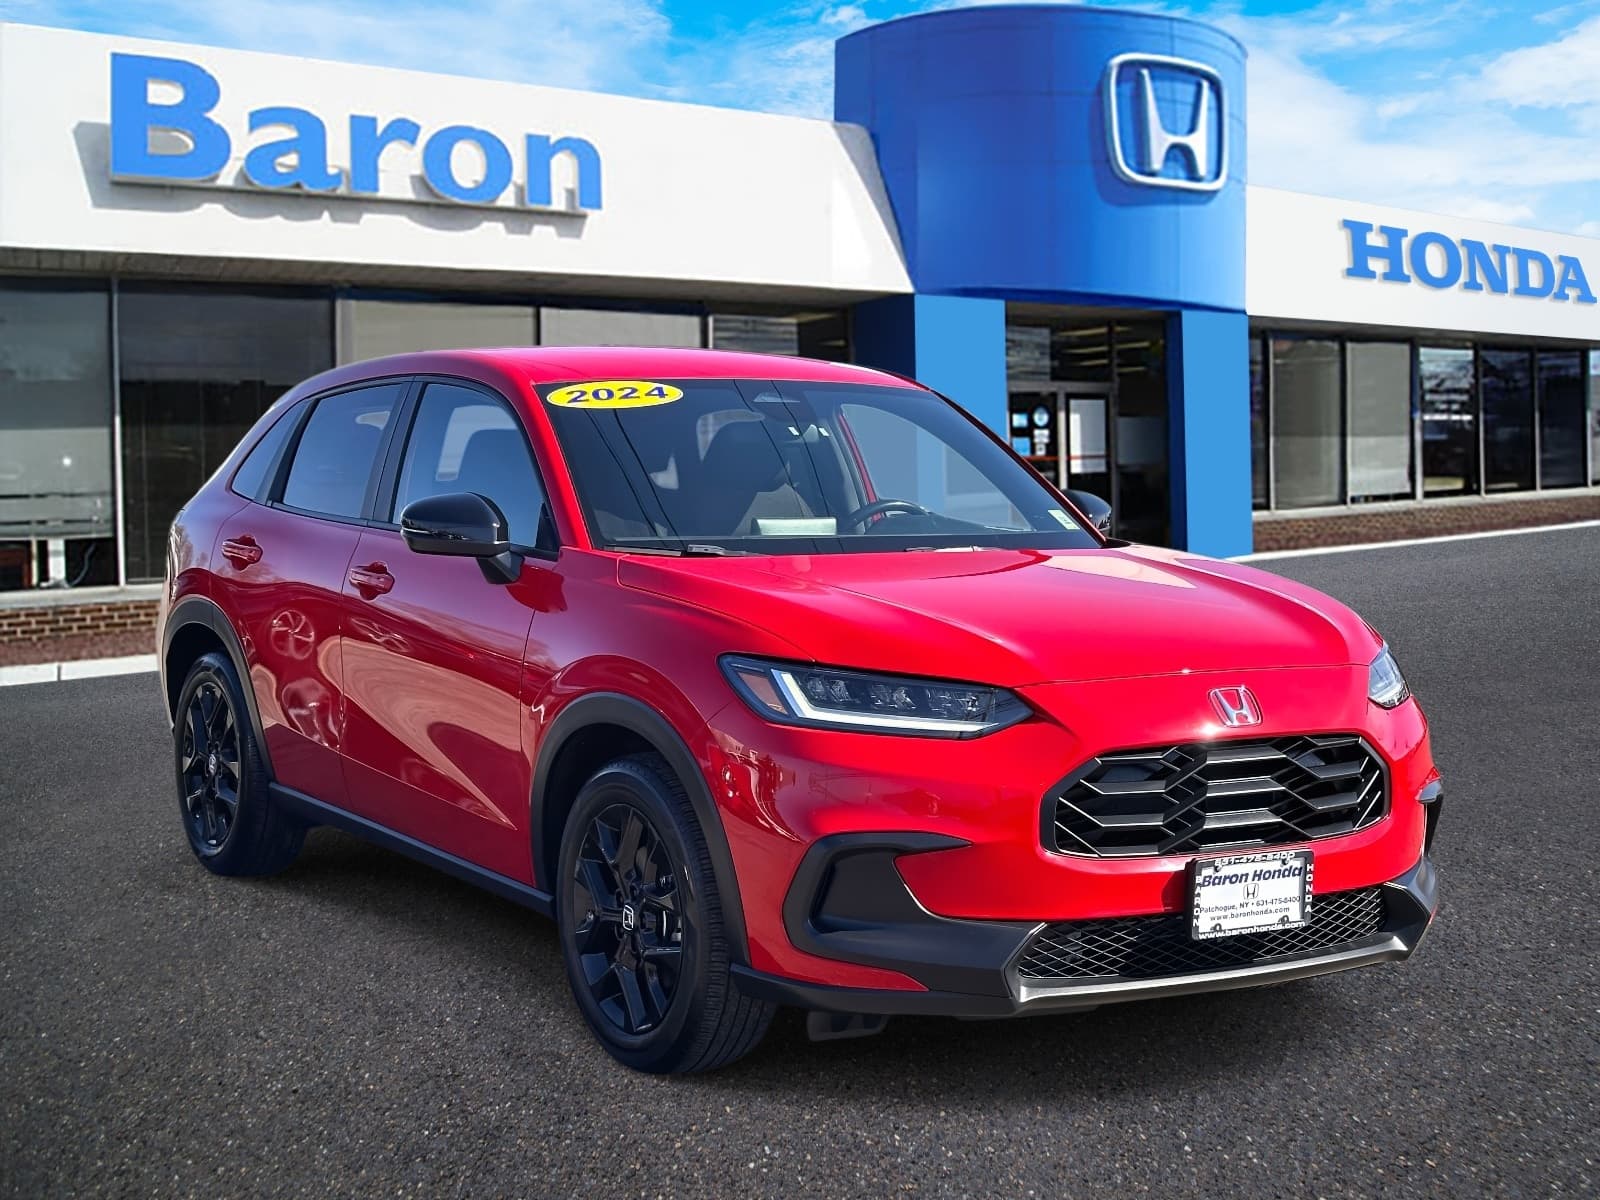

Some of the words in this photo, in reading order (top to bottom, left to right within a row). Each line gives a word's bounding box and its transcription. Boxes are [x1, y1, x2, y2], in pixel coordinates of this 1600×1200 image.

[110, 51, 604, 211] Baron
[1342, 218, 1598, 304] HONDA
[566, 386, 669, 404] 2024
[1201, 872, 1249, 887] Baron
[1251, 865, 1303, 881] Honda
[1305, 864, 1314, 913] HONDA
[1210, 907, 1290, 921] www.baronhonda.com
[1239, 900, 1250, 909] NY
[1198, 920, 1306, 940] www.baronhonda.com
